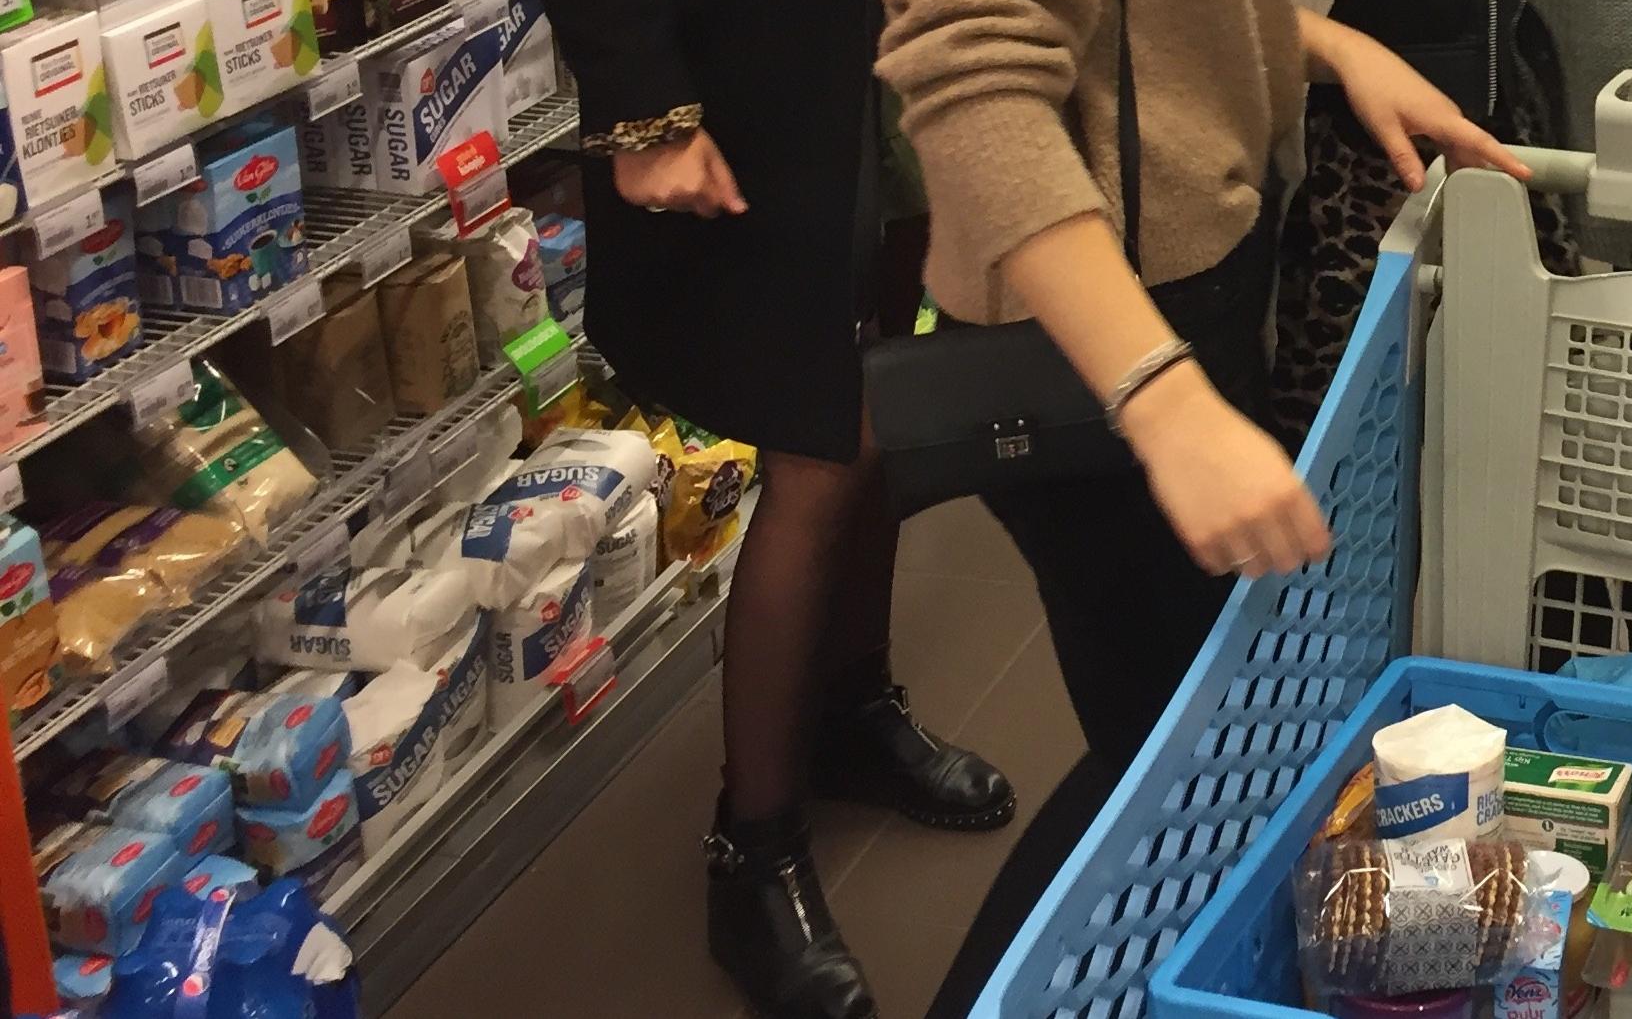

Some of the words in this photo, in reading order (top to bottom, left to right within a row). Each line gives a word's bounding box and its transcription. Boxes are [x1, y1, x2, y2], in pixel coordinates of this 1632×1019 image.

[225, 48, 262, 75] STICKS
[128, 88, 166, 117] STICKS
[418, 51, 478, 135] SUGAR
[22, 123, 77, 161] KLONTJES
[345, 103, 372, 177] SUGAR
[385, 108, 411, 183] SUGAR
[516, 466, 601, 489] SUGAR
[371, 724, 438, 808] SUGAR
[1375, 792, 1445, 827] CRACKERS
